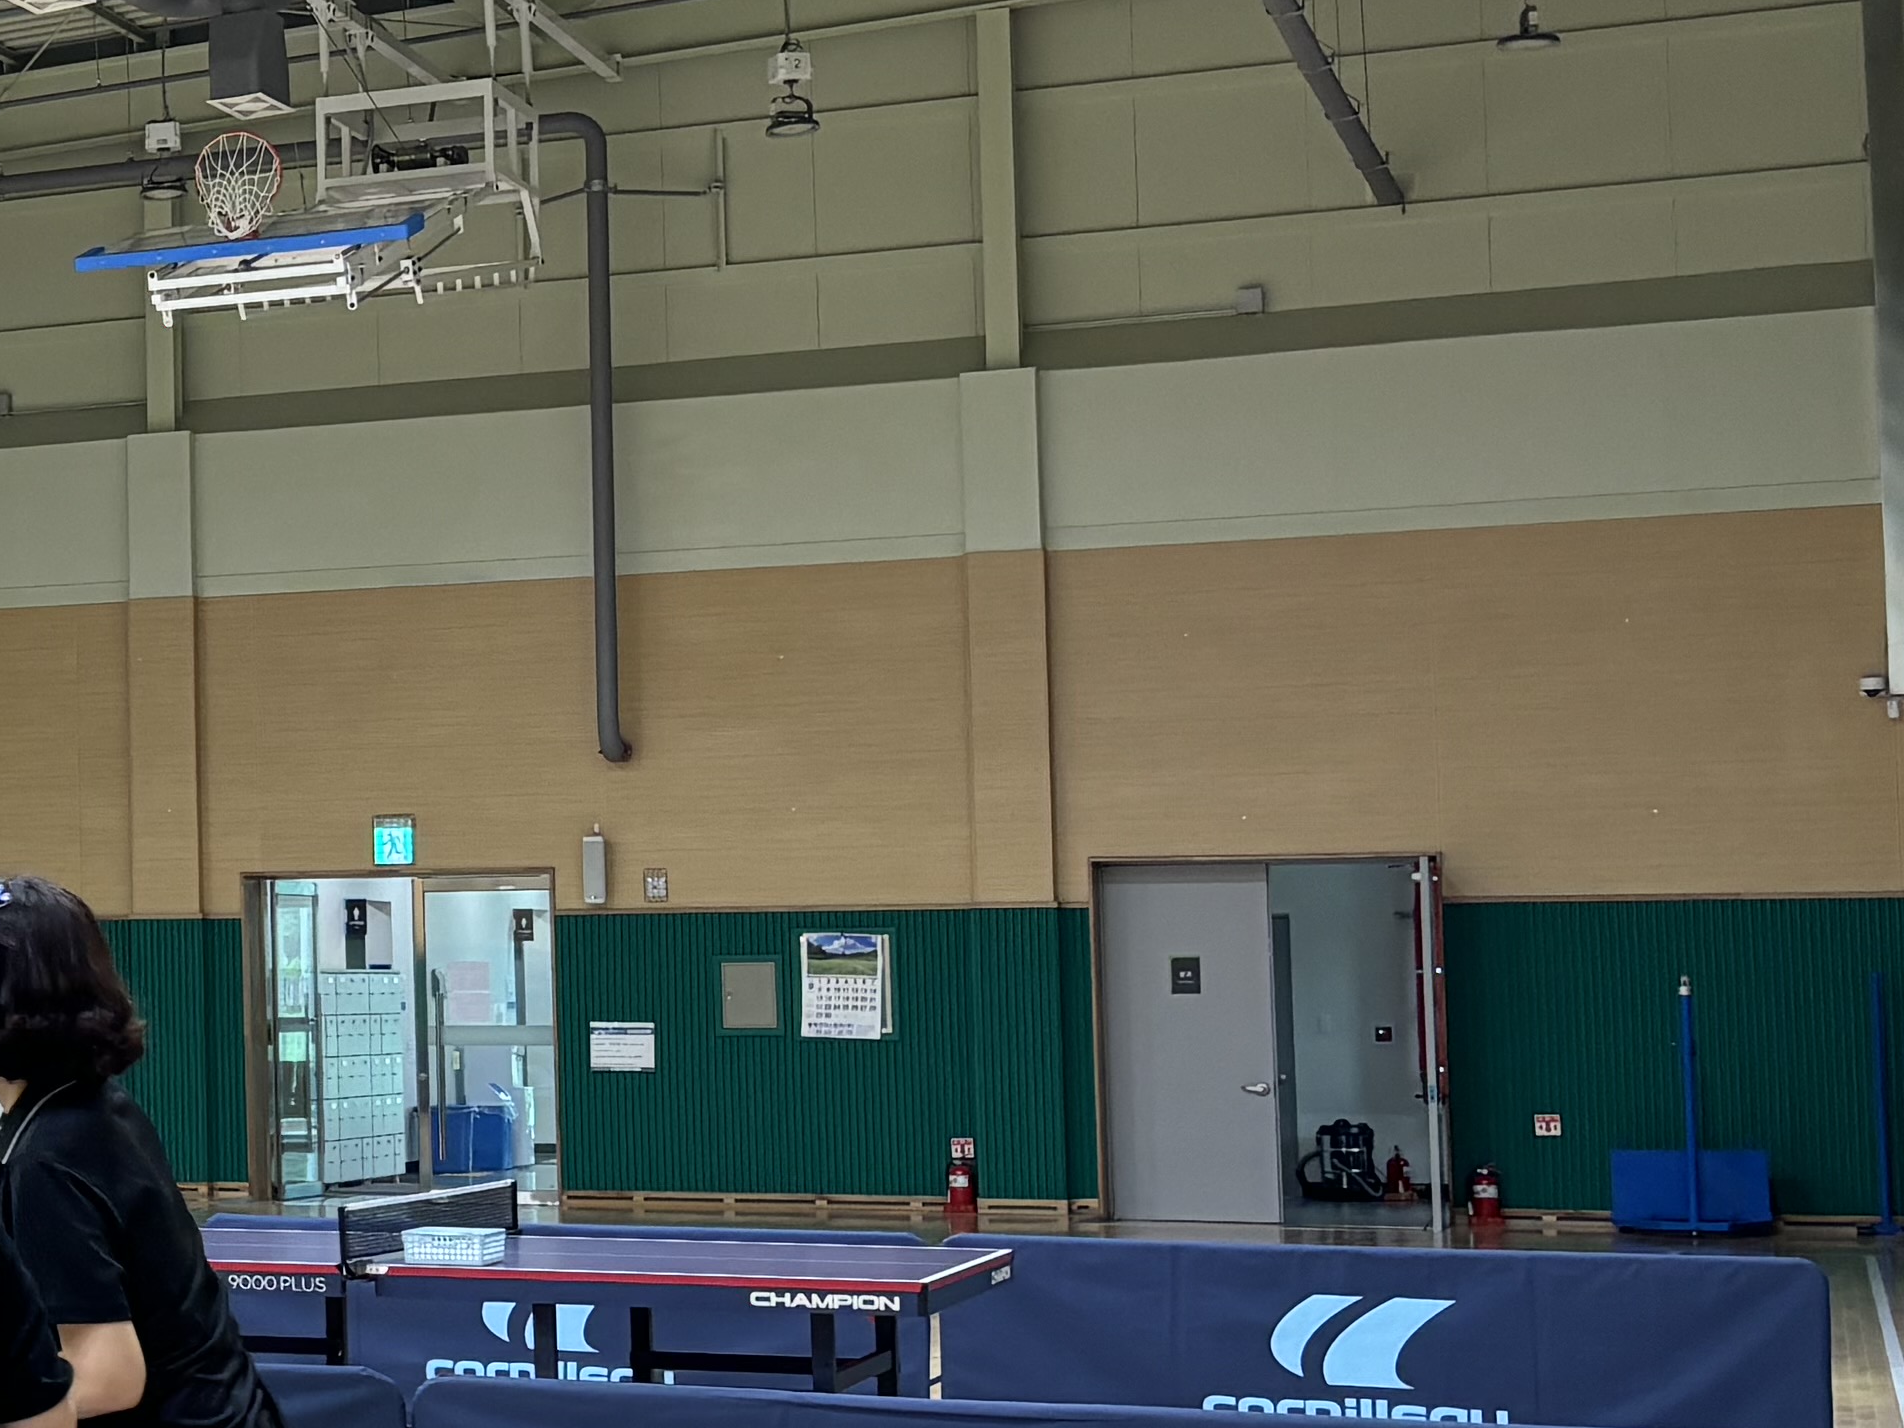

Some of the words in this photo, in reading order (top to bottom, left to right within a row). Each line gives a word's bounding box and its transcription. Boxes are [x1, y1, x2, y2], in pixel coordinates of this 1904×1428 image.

[794, 58, 801, 69] 2
[228, 1274, 277, 1291] 9000
[279, 1275, 327, 1293] PLUS
[749, 1291, 901, 1312] CHAMPION
